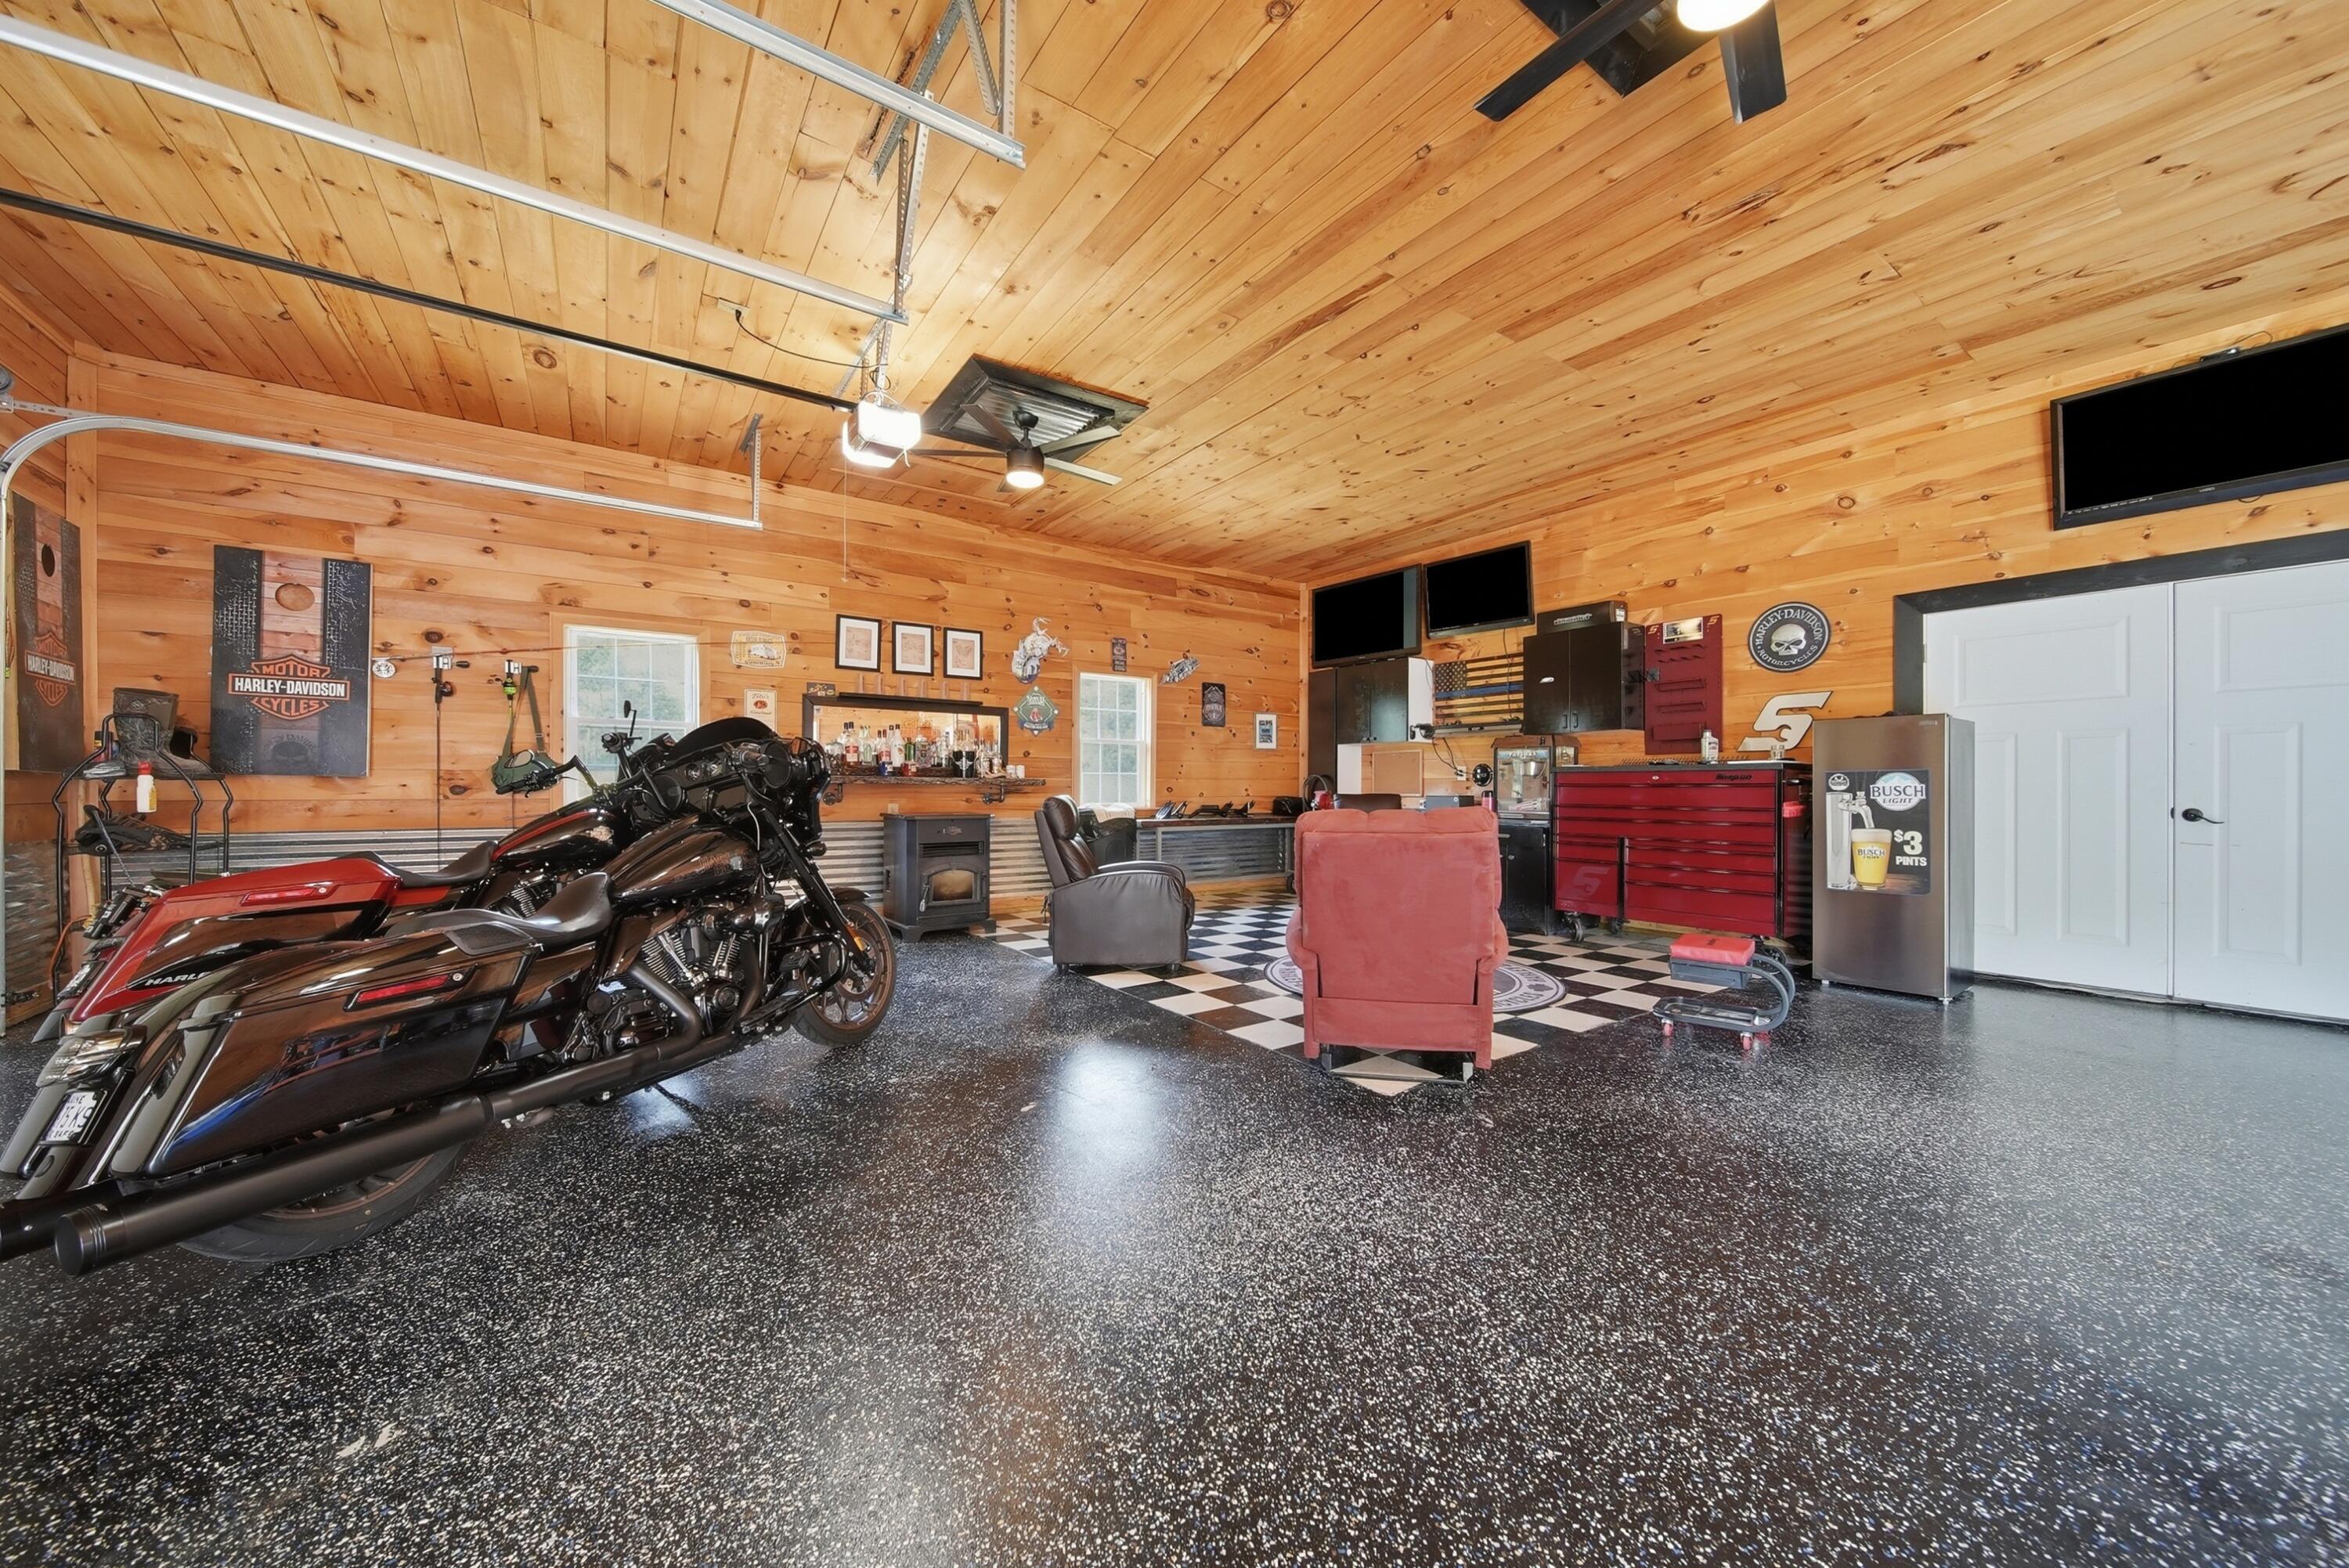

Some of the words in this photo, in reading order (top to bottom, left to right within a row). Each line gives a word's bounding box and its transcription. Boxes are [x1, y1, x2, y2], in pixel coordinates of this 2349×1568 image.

[1758, 644, 1818, 665] MOTORCYCLES
[262, 661, 320, 677] MOTOR
[235, 677, 345, 697] HARLEY-DAVIDSON
[261, 697, 319, 716] CYCLES
[1872, 785, 1924, 797] BUSCH
[1896, 856, 1927, 867] PINTS
